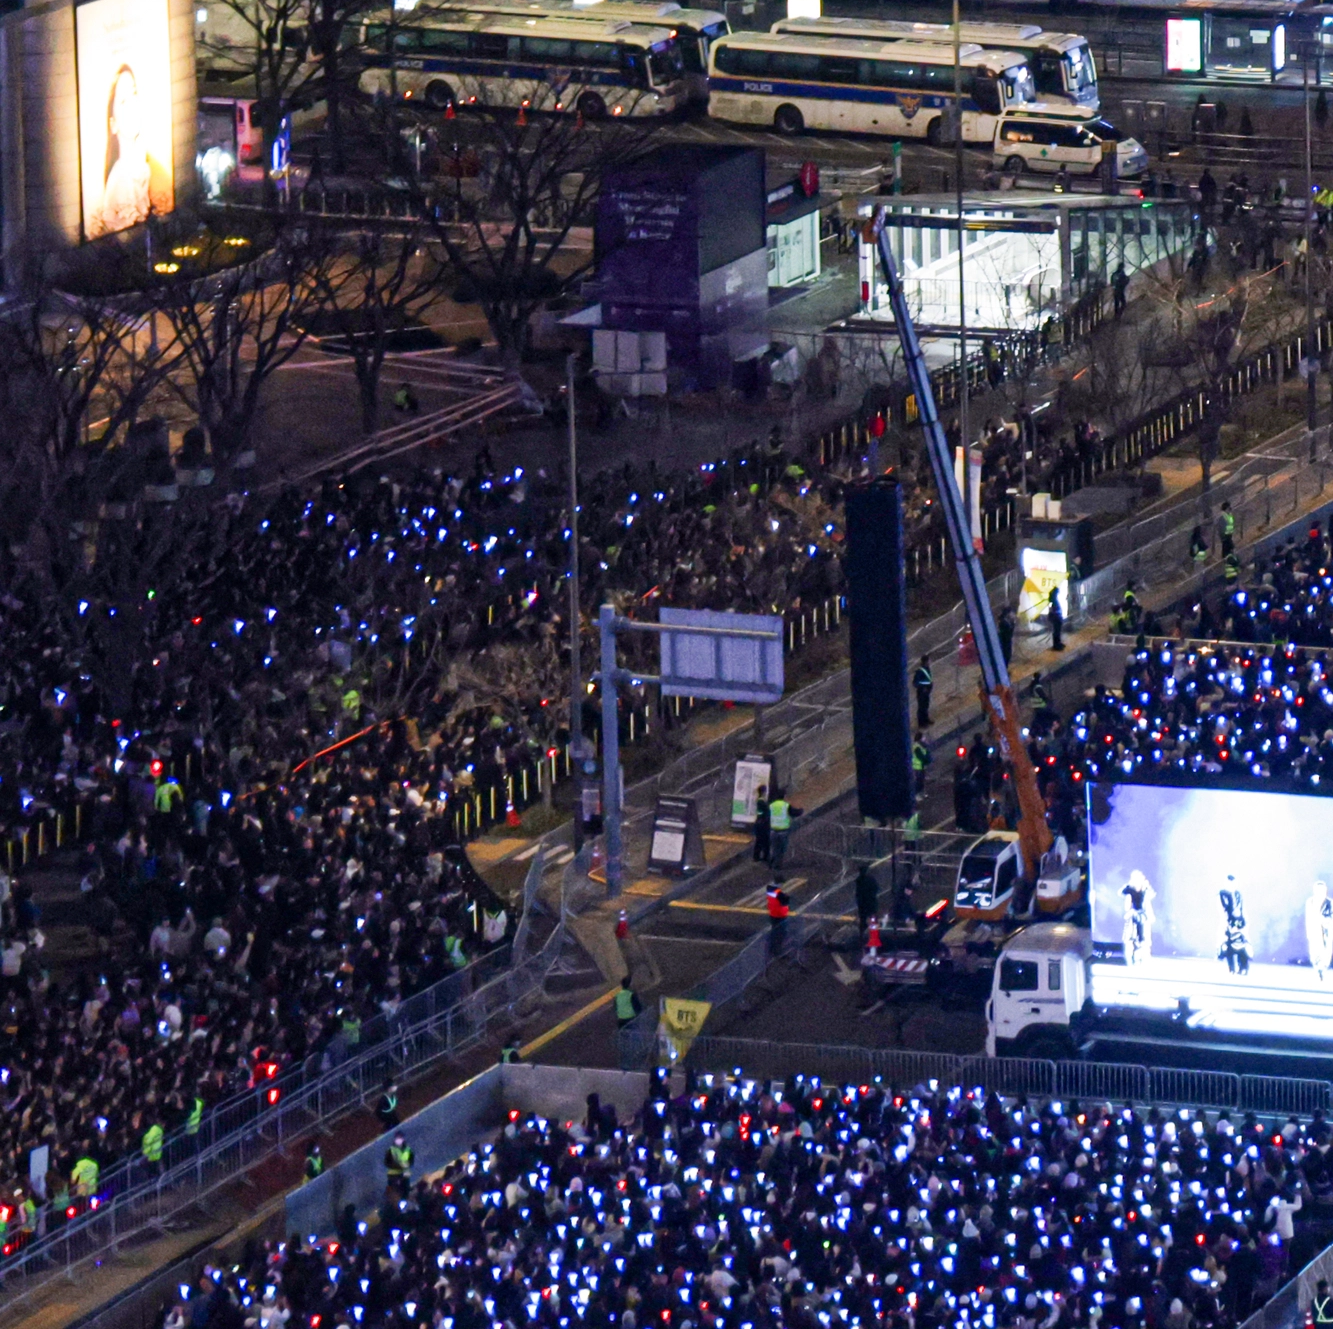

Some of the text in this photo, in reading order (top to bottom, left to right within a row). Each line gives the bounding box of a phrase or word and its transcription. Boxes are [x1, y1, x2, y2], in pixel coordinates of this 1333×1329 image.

[744, 82, 774, 93] POLICE
[1041, 577, 1057, 588] BTS
[677, 1009, 698, 1023] BTS
